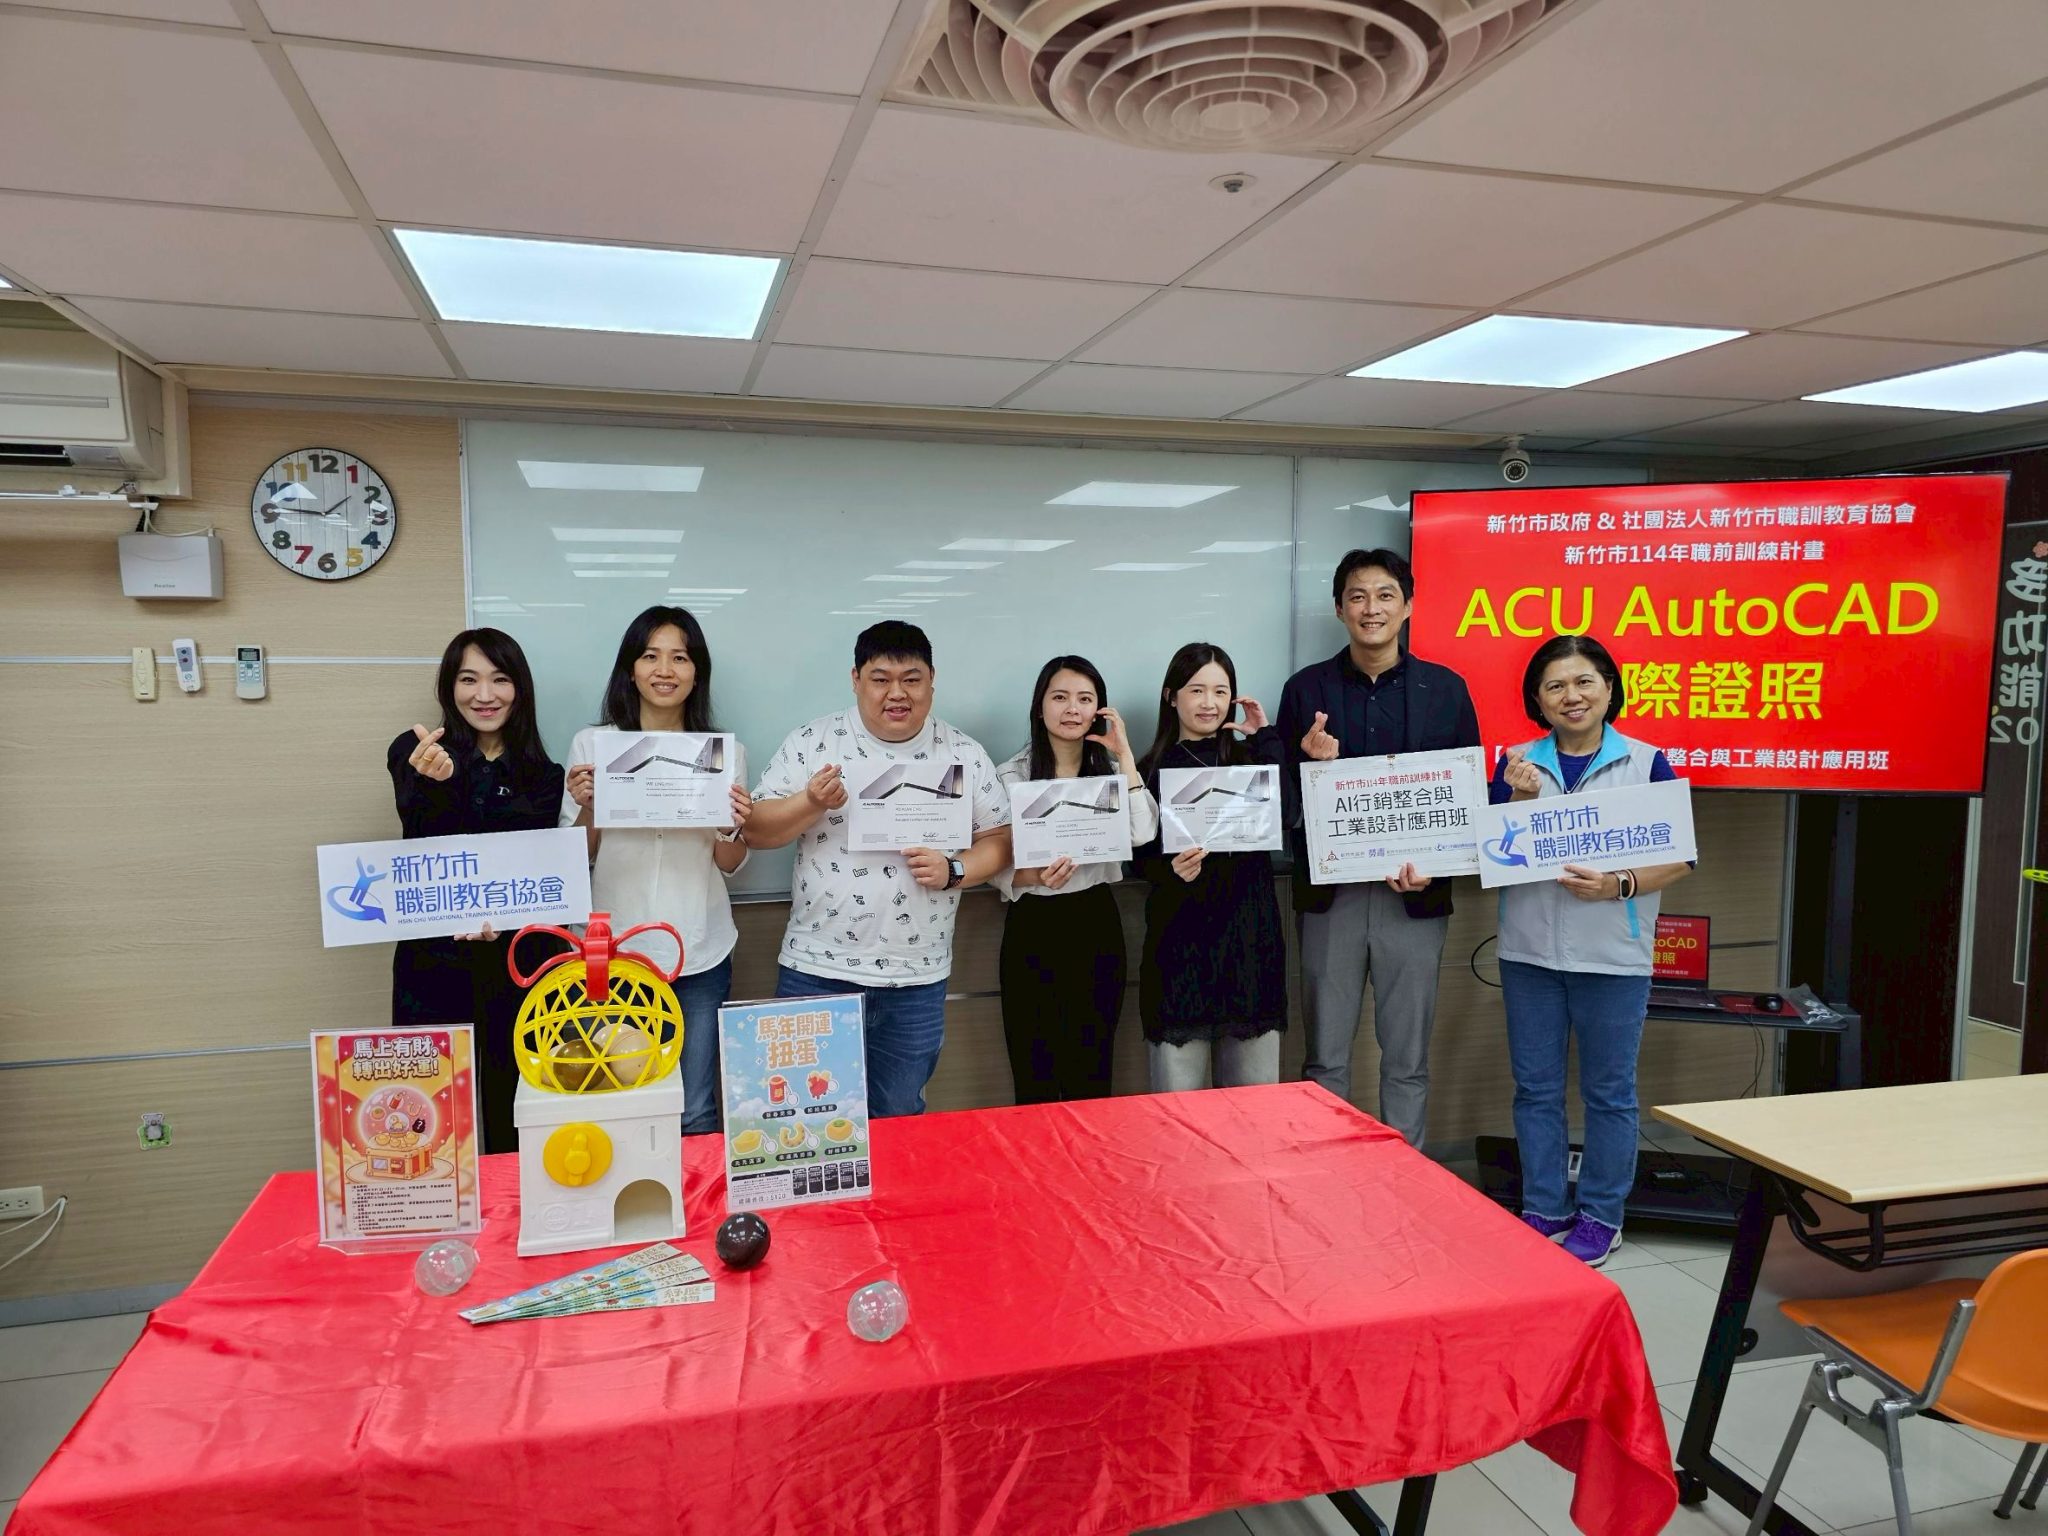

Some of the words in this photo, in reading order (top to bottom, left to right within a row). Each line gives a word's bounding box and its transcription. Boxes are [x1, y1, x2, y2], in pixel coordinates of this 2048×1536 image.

[281, 462, 308, 482] 11
[308, 453, 339, 474] 12
[346, 464, 359, 484] 1
[265, 481, 299, 502] 10
[363, 485, 382, 504] 2
[260, 502, 281, 524] 9
[1486, 511, 1591, 533] 新竹市政府
[1597, 511, 1617, 531] &
[1621, 503, 1917, 530] 社團法人新竹市職訓教育協會
[272, 530, 291, 550] 8
[360, 531, 381, 549] 4
[294, 545, 314, 565] 7
[317, 552, 338, 573] 6
[345, 547, 364, 567] 5
[1564, 540, 1825, 565] 新竹市114年職前訓練計畫
[1455, 586, 1594, 638] ACU
[1613, 582, 1940, 637] AutoCAD
[1658, 748, 1889, 771] 整合與工業設計應用班
[1335, 769, 1453, 792] 新竹市114年職前訓練計畫
[1335, 785, 1454, 814] AI行銷整合與
[1328, 807, 1470, 838] 工業設計應用班
[1529, 804, 1600, 836] 新竹市
[1533, 822, 1673, 861] 職訓教育協會
[391, 851, 479, 884] 新竹市
[395, 876, 565, 915] 職訓教育協會
[427, 914, 463, 922] VOCATIONAL
[465, 911, 493, 919] TRAINING
[499, 907, 531, 916] EDUCATION
[532, 904, 569, 912] ASSOCIATION
[756, 1011, 833, 1042] 馬年開運
[768, 1038, 819, 1068] 扭蛋
